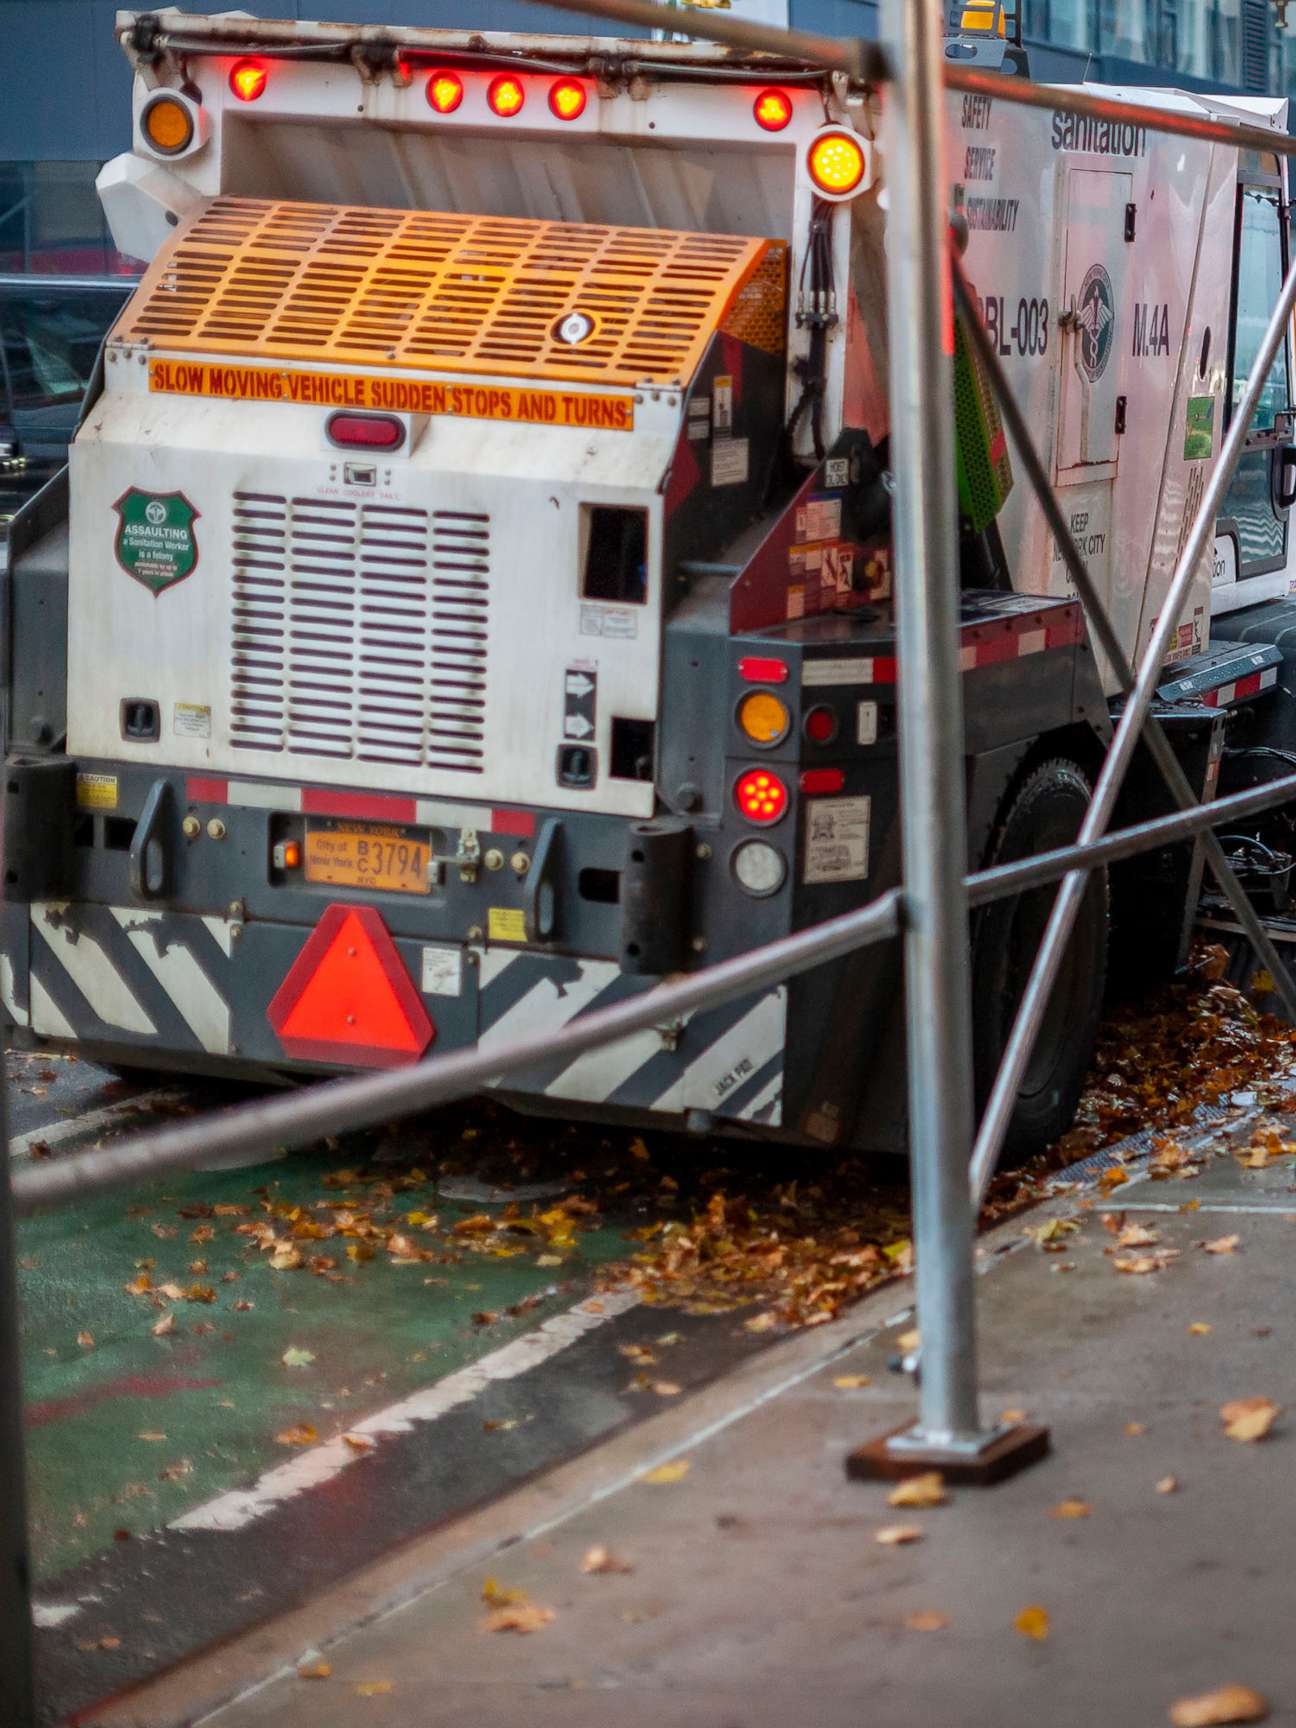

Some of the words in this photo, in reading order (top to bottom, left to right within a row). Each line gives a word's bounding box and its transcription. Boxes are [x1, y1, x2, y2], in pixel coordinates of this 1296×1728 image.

[961, 94, 993, 130] SAFETY
[1051, 111, 1146, 157] sanitation
[964, 145, 997, 181] SERVICE
[1132, 302, 1170, 357] M.4A
[154, 363, 204, 392] SLOW
[209, 367, 283, 399] MOVING
[287, 373, 365, 406] VEHICLE
[371, 380, 447, 412] SUDDEN
[451, 387, 512, 418] STOPS
[517, 393, 556, 421] AND
[561, 396, 627, 427] TURNS
[125, 525, 188, 539] ASSAULTING
[1070, 512, 1089, 533] KEEP
[129, 537, 163, 548] Sanitation
[165, 541, 189, 551] Worker
[1088, 533, 1106, 555] CITY
[152, 550, 173, 561] felony
[85, 775, 116, 783] CAUTION
[311, 855, 330, 865] New
[335, 857, 353, 867] York
[317, 840, 335, 853] City
[337, 842, 347, 851] of
[358, 841, 368, 855] B
[372, 842, 422, 879] 3794
